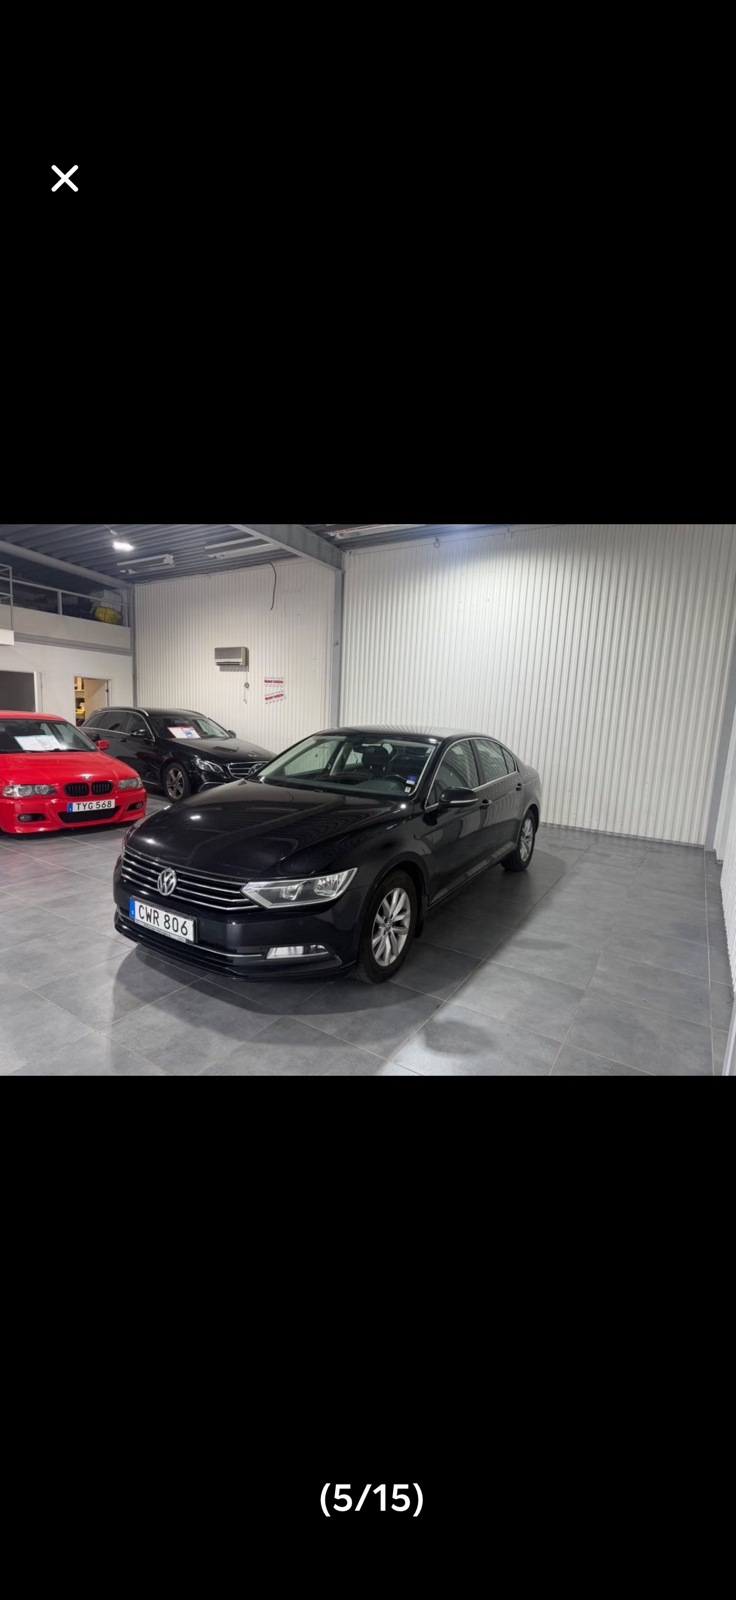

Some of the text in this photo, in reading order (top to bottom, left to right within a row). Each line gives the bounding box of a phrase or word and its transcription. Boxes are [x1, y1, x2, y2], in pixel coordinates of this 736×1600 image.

[76, 802, 93, 811] TYG
[95, 800, 112, 809] 568
[138, 904, 160, 926] CWR
[163, 914, 188, 936] 806
